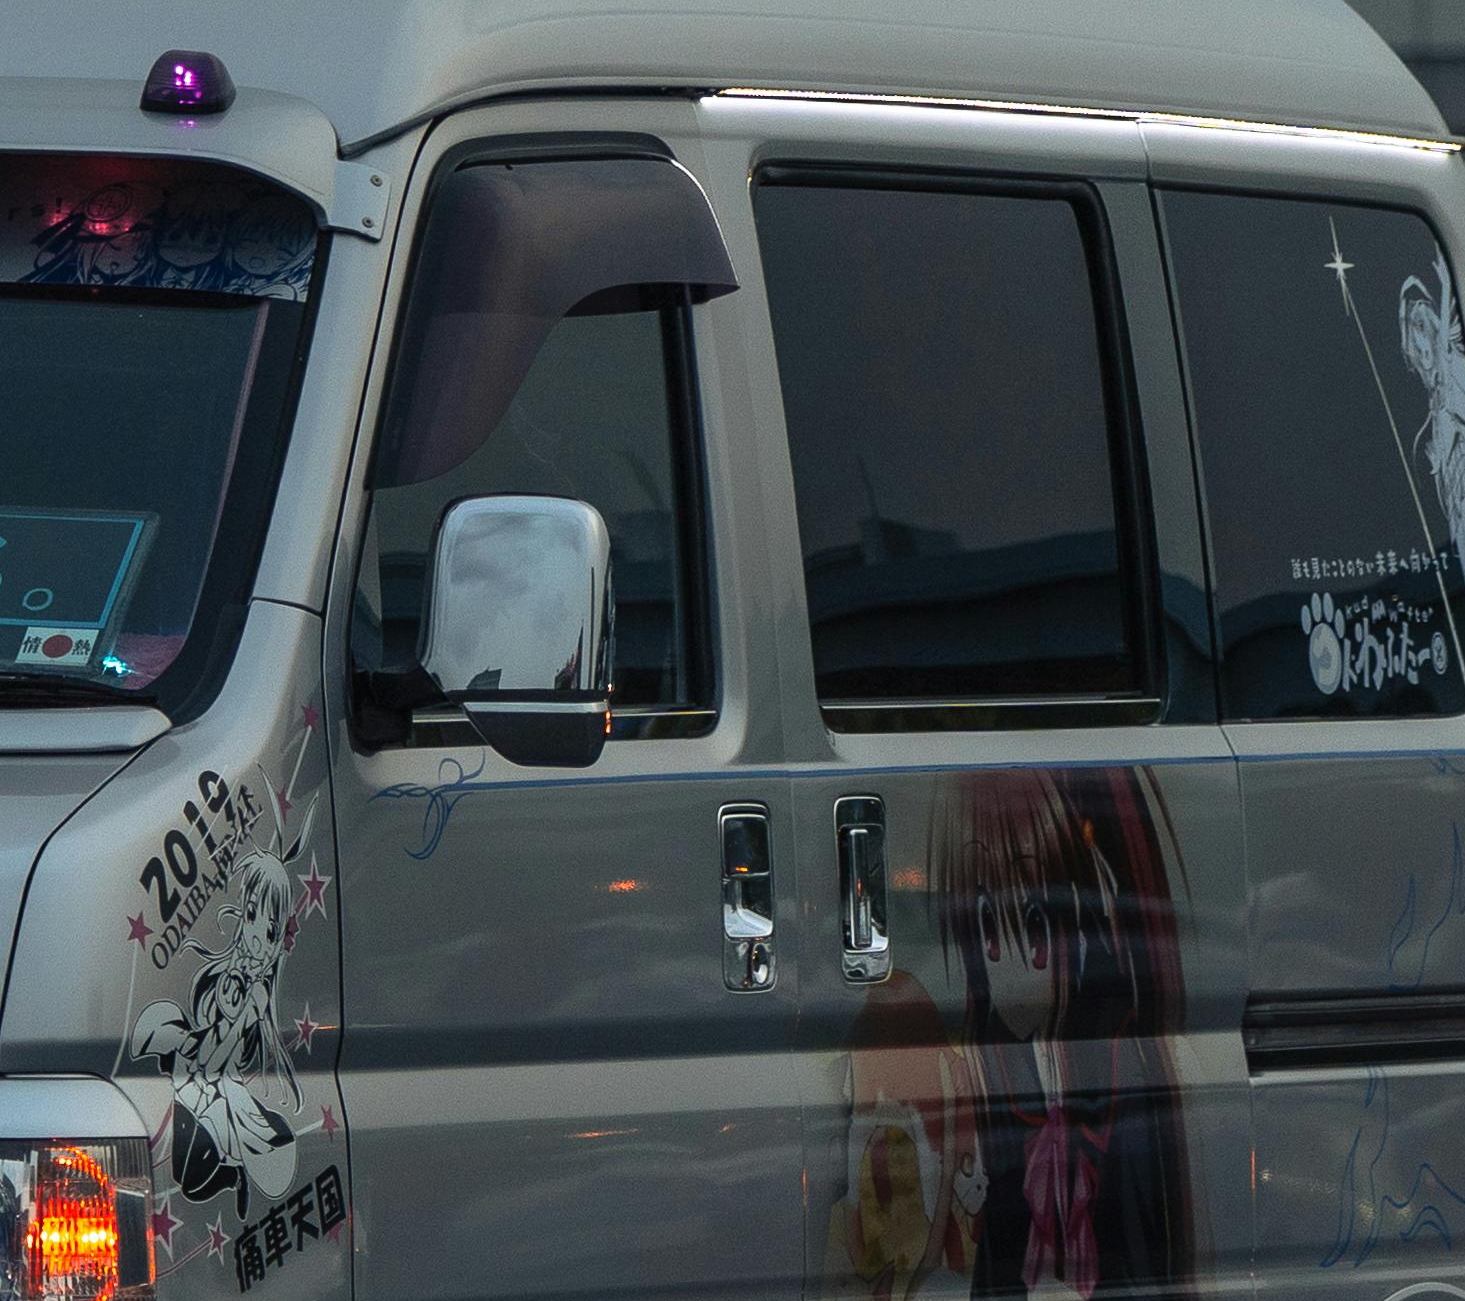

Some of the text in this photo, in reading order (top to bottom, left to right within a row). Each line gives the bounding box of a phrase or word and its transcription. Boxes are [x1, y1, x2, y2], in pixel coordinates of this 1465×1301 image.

[139, 770, 236, 924] 2019
[234, 1163, 349, 1294] 痛車天国
